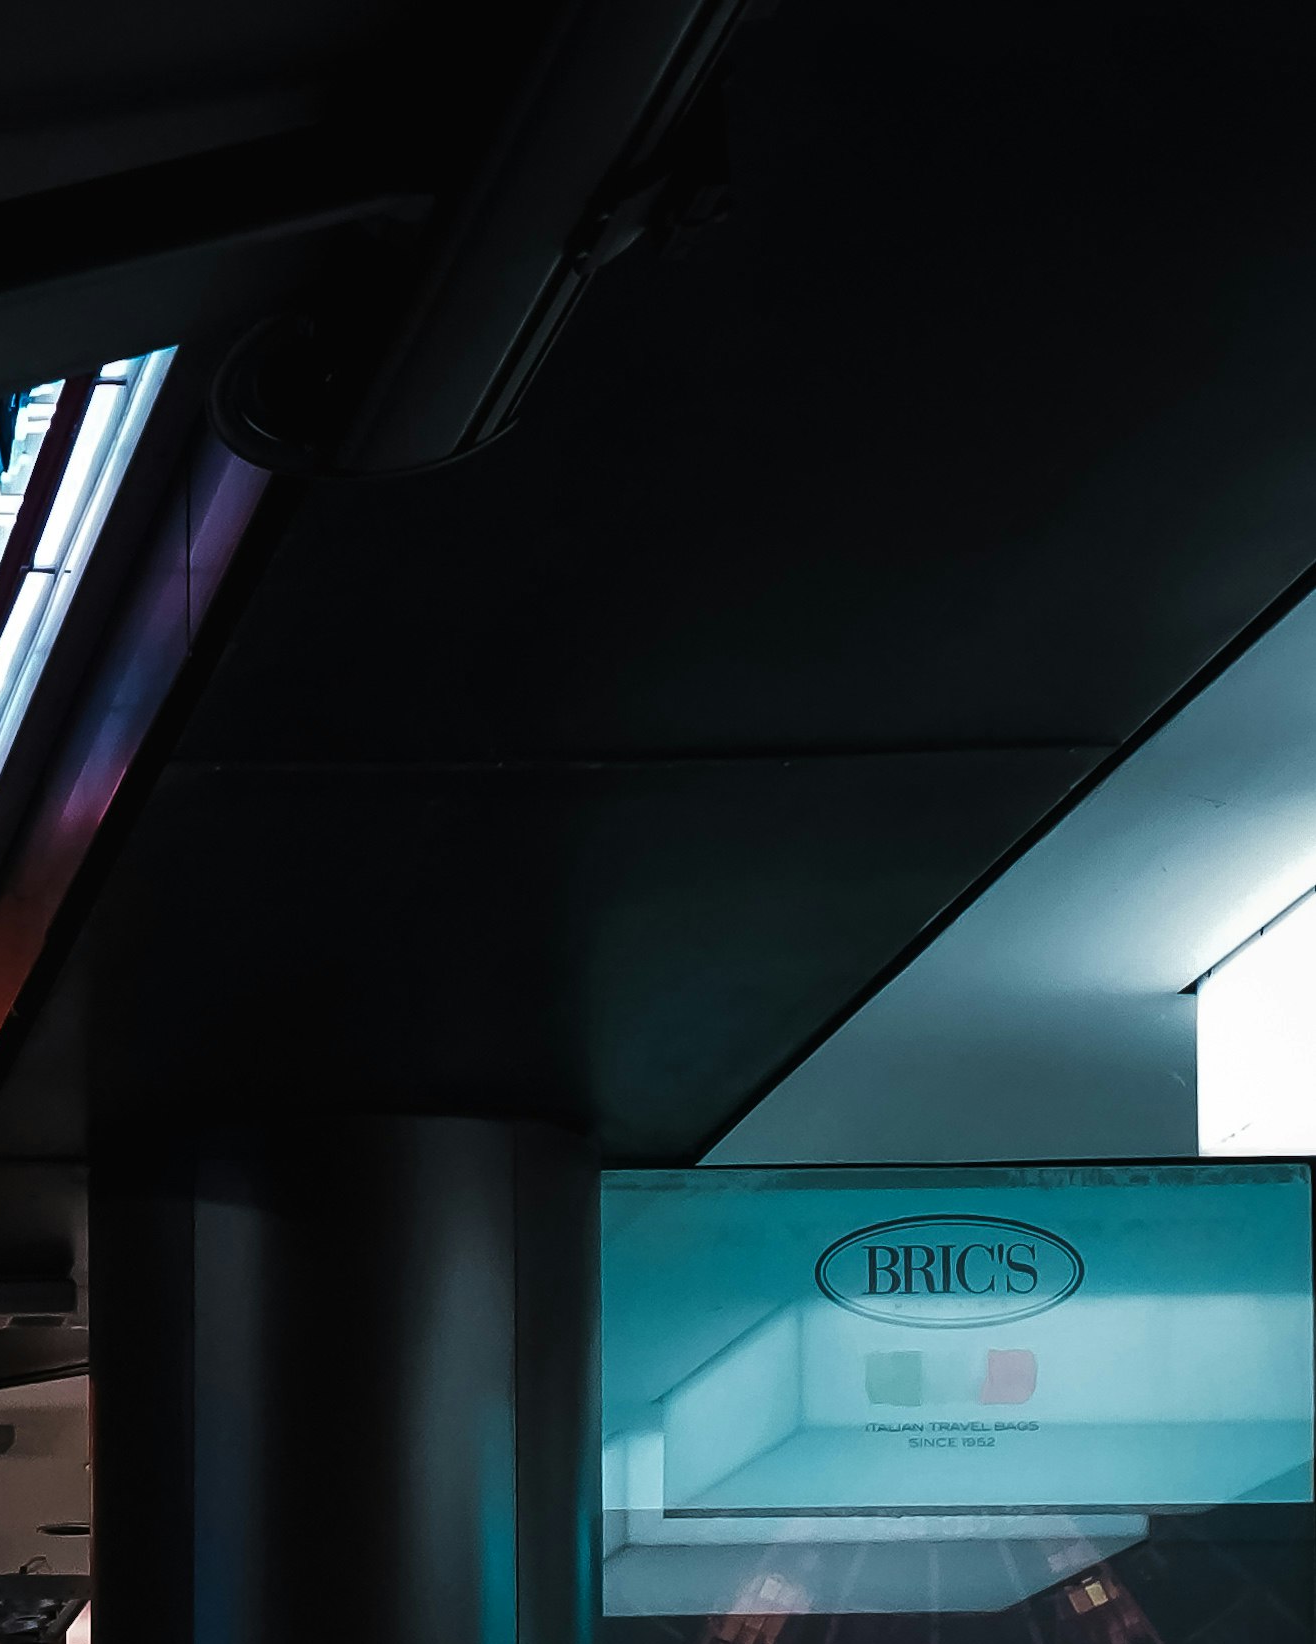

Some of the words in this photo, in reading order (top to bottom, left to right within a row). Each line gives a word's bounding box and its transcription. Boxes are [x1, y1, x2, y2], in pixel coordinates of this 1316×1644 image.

[861, 1243, 1039, 1295] BRIC'S
[865, 1422, 925, 1433] ITALIAN
[930, 1421, 992, 1432] TRAVEL
[993, 1421, 1040, 1432] BAGS
[908, 1437, 957, 1448] SINCE
